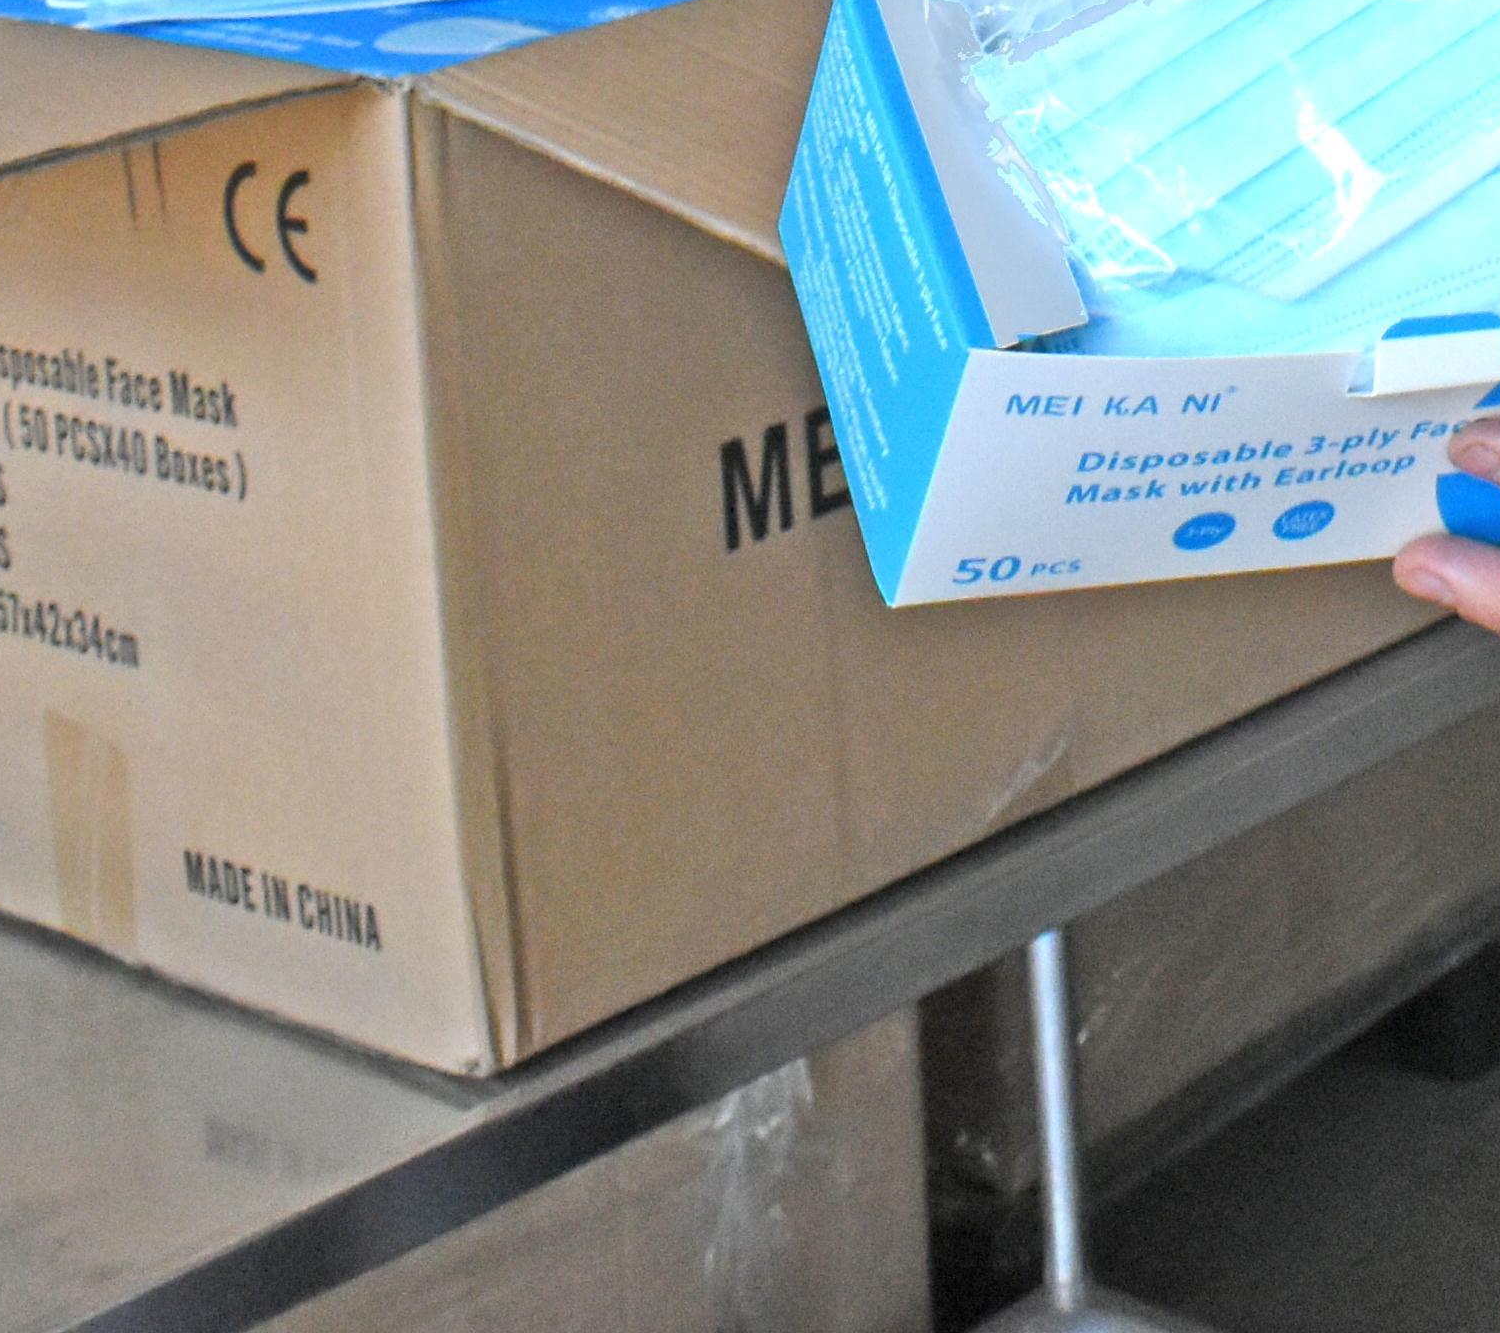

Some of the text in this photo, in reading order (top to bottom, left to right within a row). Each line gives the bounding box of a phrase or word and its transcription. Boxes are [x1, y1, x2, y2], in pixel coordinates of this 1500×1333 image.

[223, 159, 318, 284] CE
[105, 356, 162, 412] Face
[169, 368, 238, 428] Mask
[1005, 393, 1084, 416] MEI
[1103, 395, 1159, 416] KA
[1075, 420, 1469, 474] Disposable 3-ply Fac
[719, 405, 852, 554] ME
[1064, 454, 1416, 505] Mask with Earloop
[951, 555, 1082, 584] 50 PCS
[183, 849, 382, 952] MADE IN CHINA
